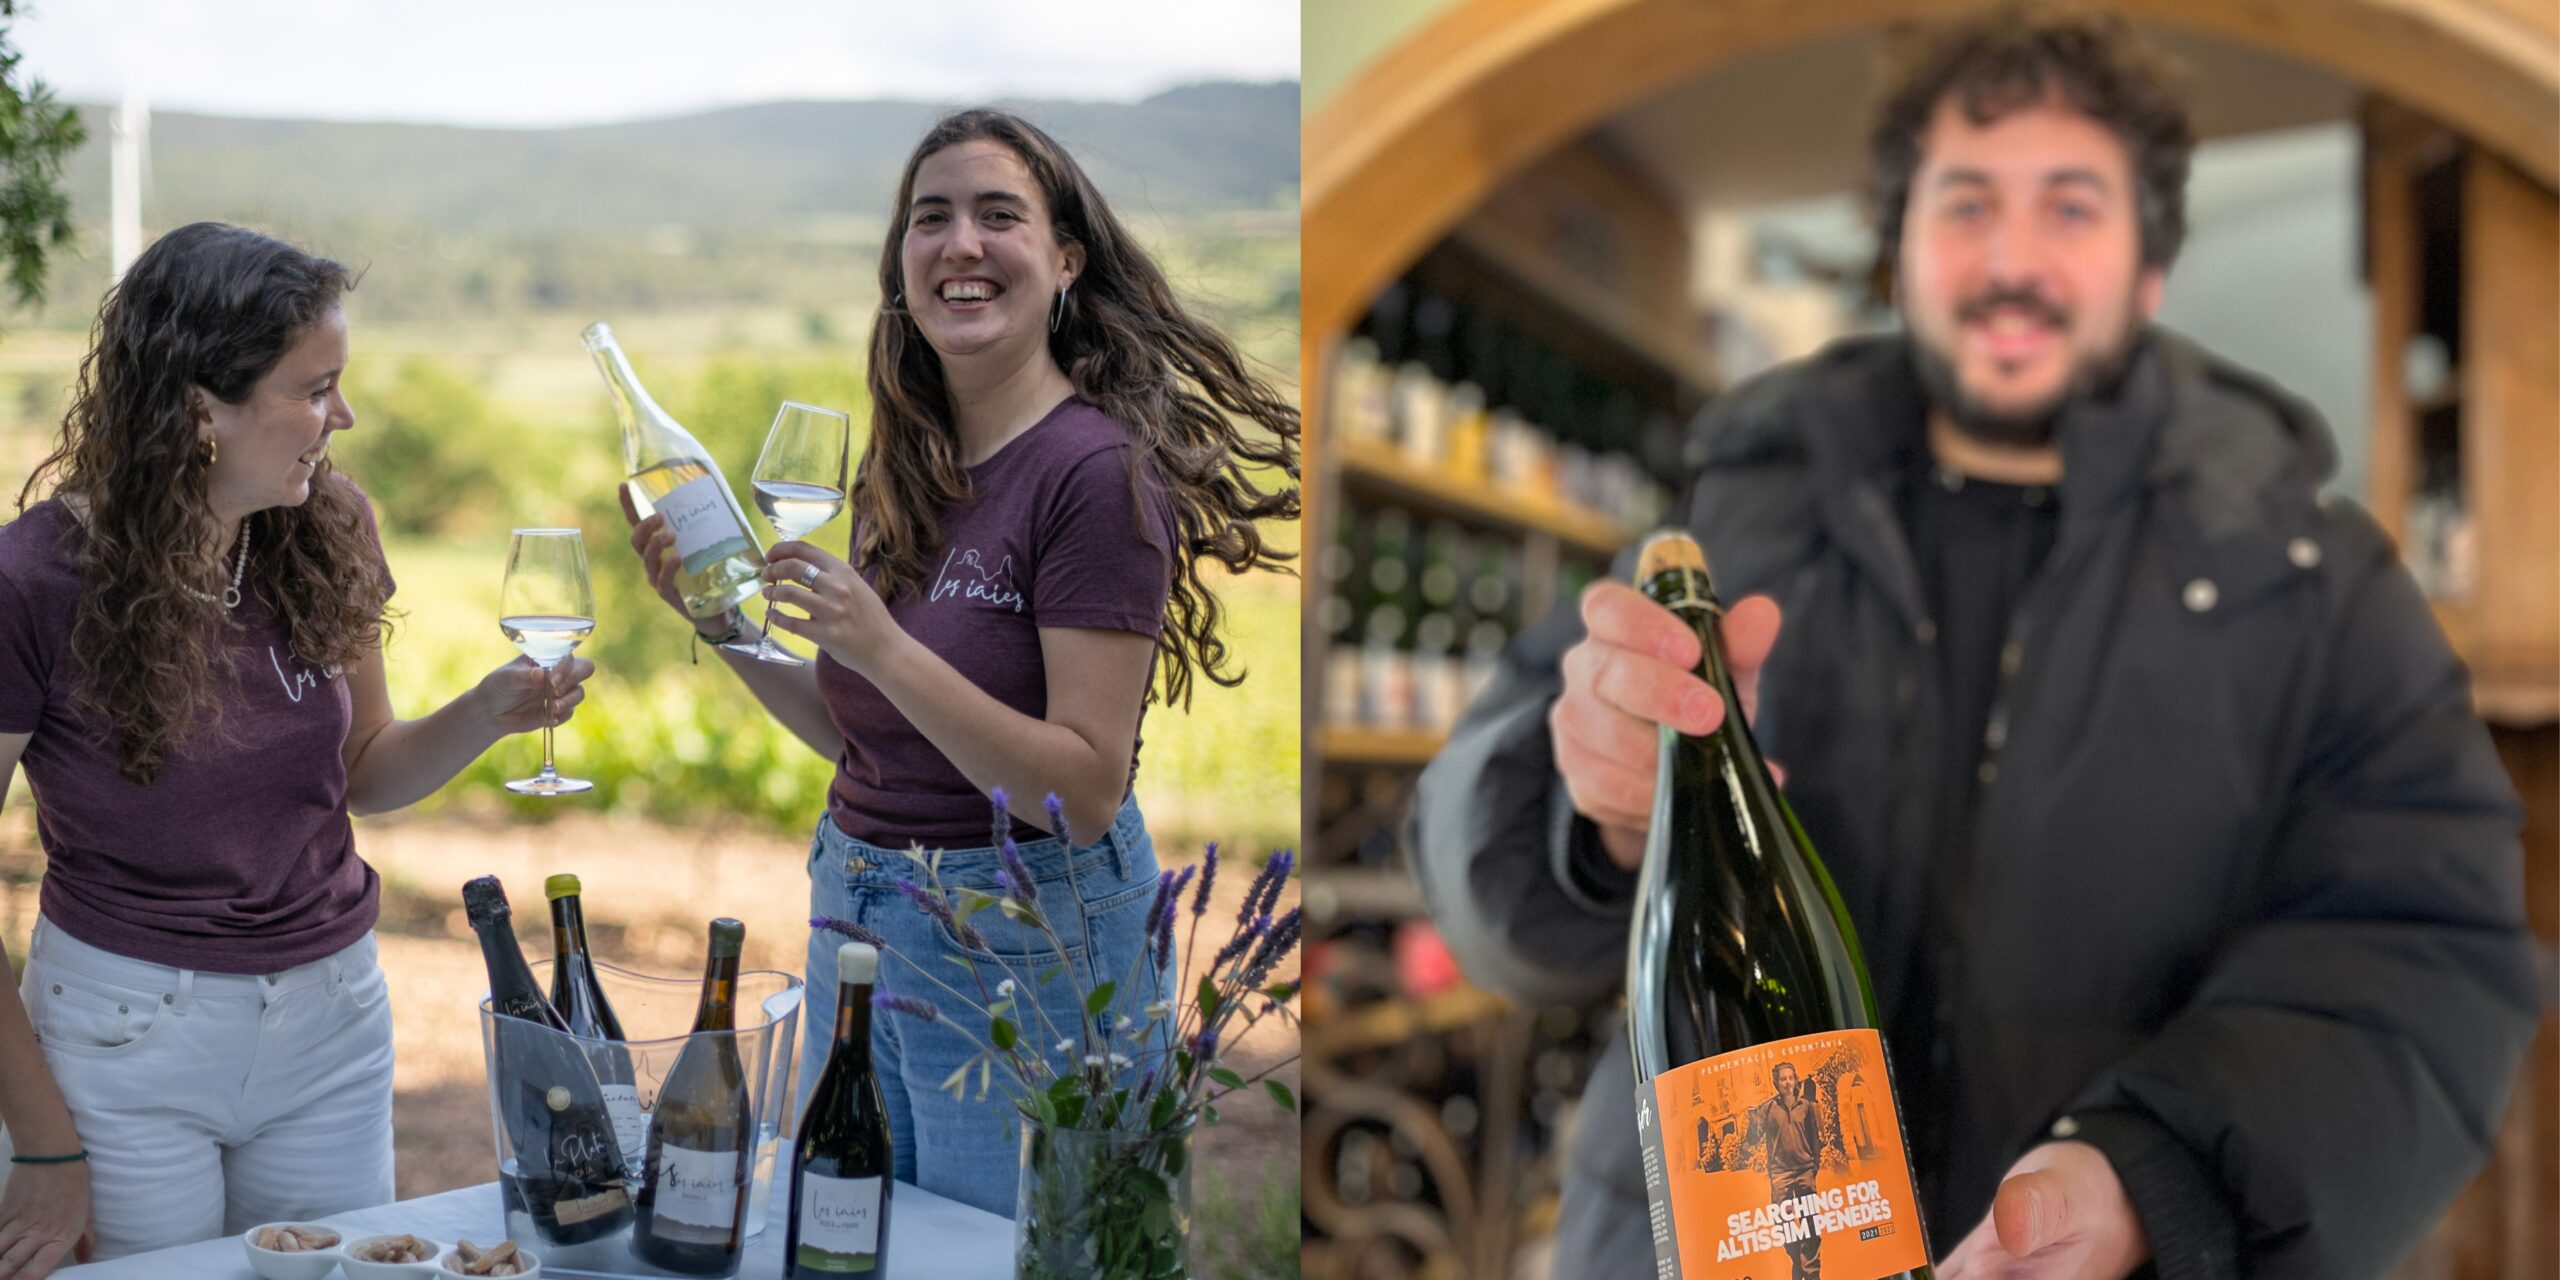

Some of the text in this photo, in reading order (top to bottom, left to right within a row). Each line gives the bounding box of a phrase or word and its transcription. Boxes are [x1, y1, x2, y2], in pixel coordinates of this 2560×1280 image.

[965, 579, 1025, 613] iaies
[1701, 1051, 1775, 1076] FERMENTACIÓ
[1727, 1180, 1882, 1236] SEARCHING FOR
[1716, 1217, 1811, 1263] ALTISSIM
[1813, 1199, 1892, 1236] PENEDES
[1861, 1228, 1878, 1240] 2021
